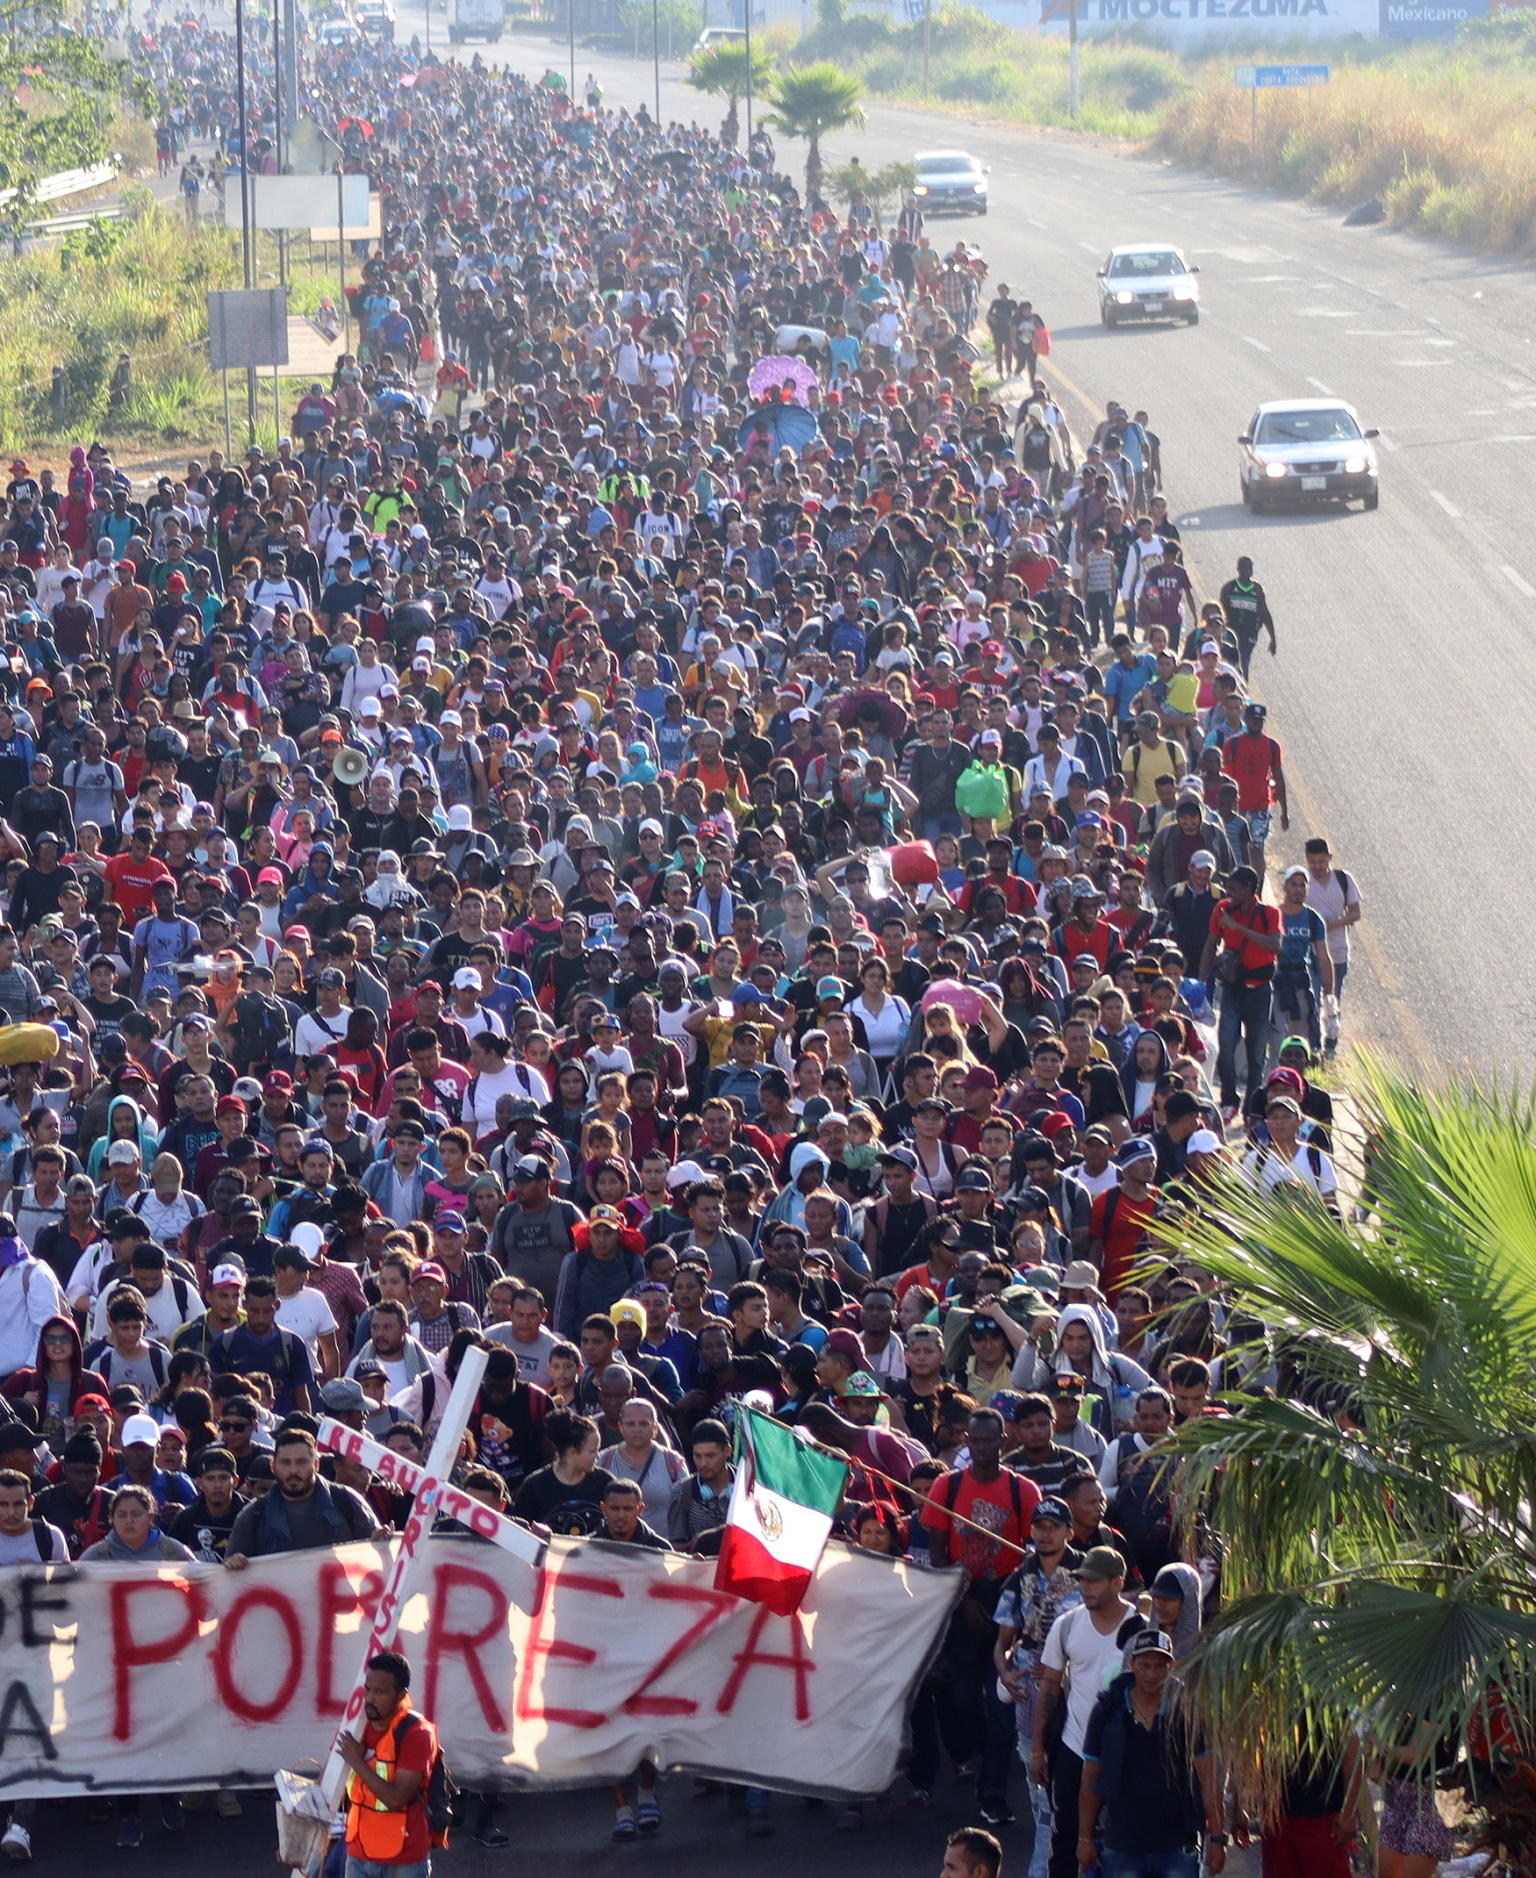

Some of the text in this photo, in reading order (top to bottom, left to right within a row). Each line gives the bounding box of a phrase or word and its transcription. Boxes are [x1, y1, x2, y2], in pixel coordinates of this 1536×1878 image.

[1099, 0, 1328, 20] MOCTEZUMA
[1387, 5, 1467, 21] Mexicano
[648, 526, 670, 534] ICON
[1158, 578, 1178, 589] MIT
[108, 1561, 817, 1741] POBREZA
